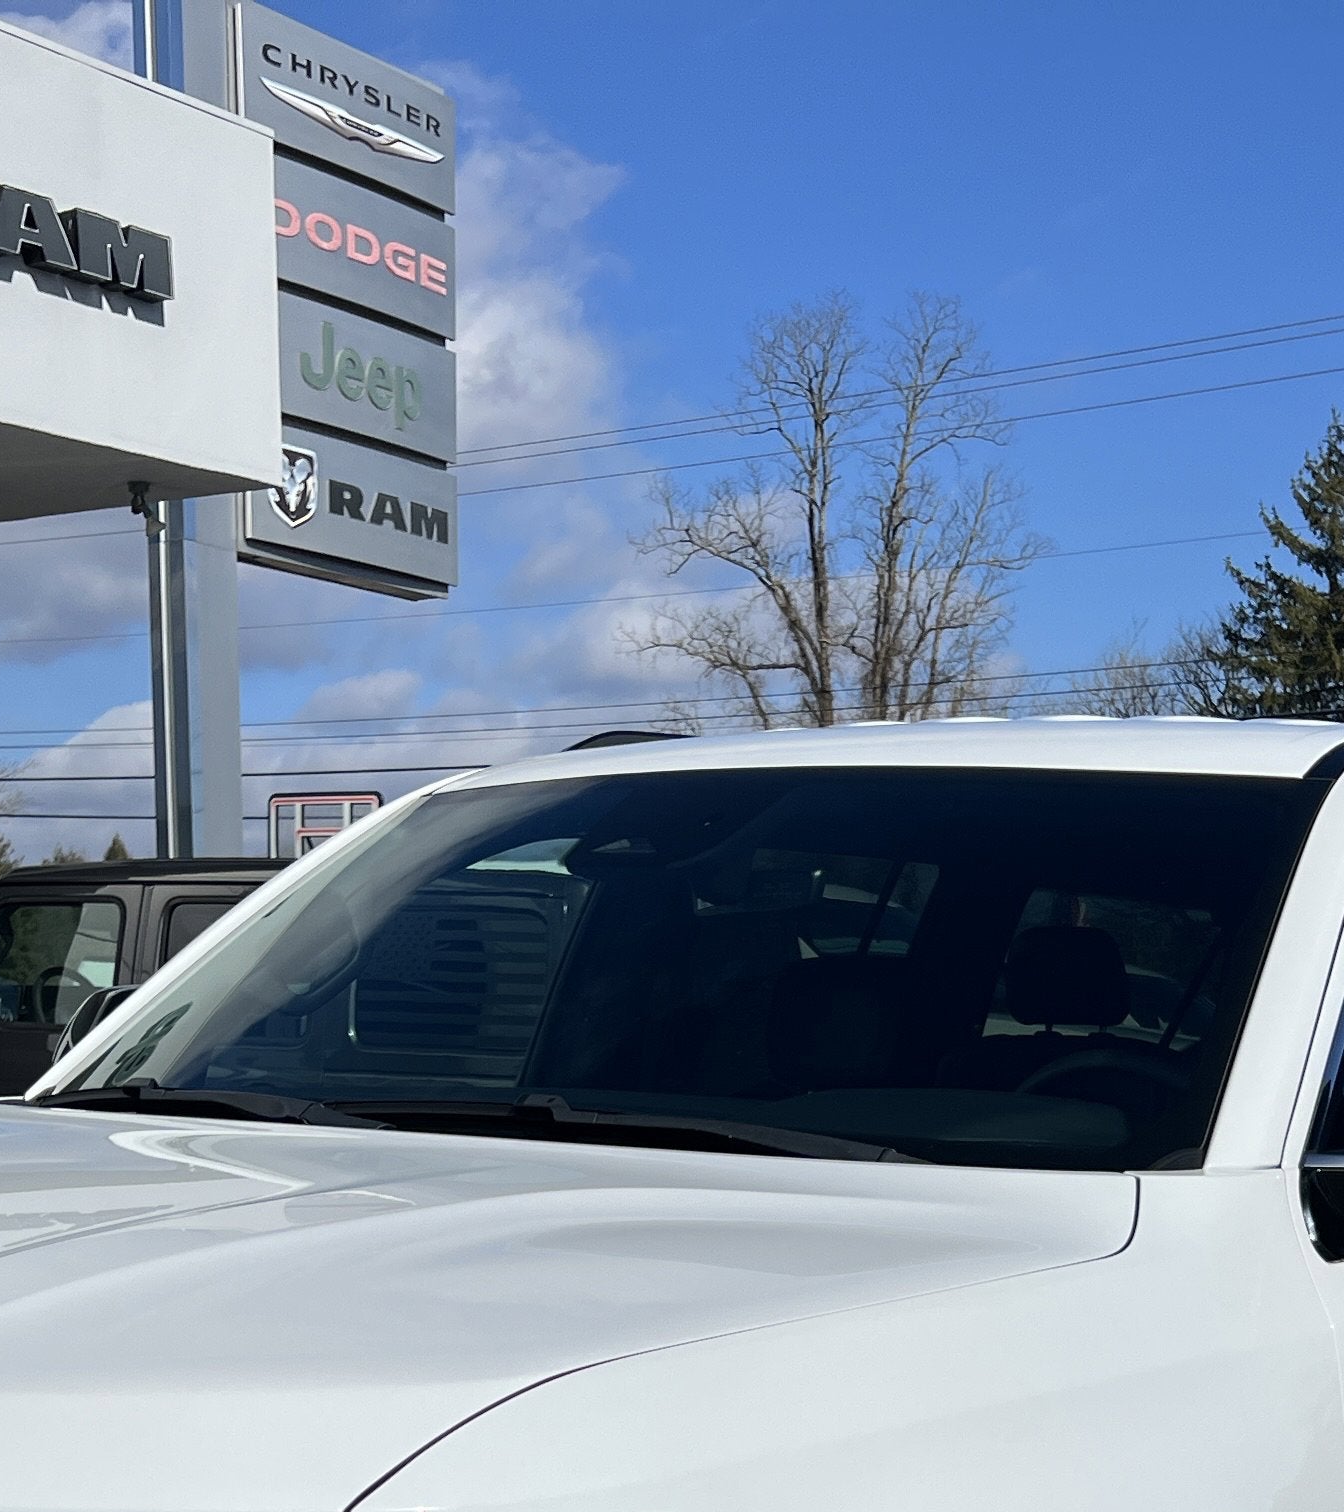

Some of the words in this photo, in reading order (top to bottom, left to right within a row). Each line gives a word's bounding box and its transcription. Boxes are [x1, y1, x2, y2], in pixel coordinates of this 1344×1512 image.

[261, 43, 441, 138] CHRYSLER
[274, 198, 448, 297] DODGE
[300, 320, 422, 432] Jeep
[329, 479, 449, 545] RAM
